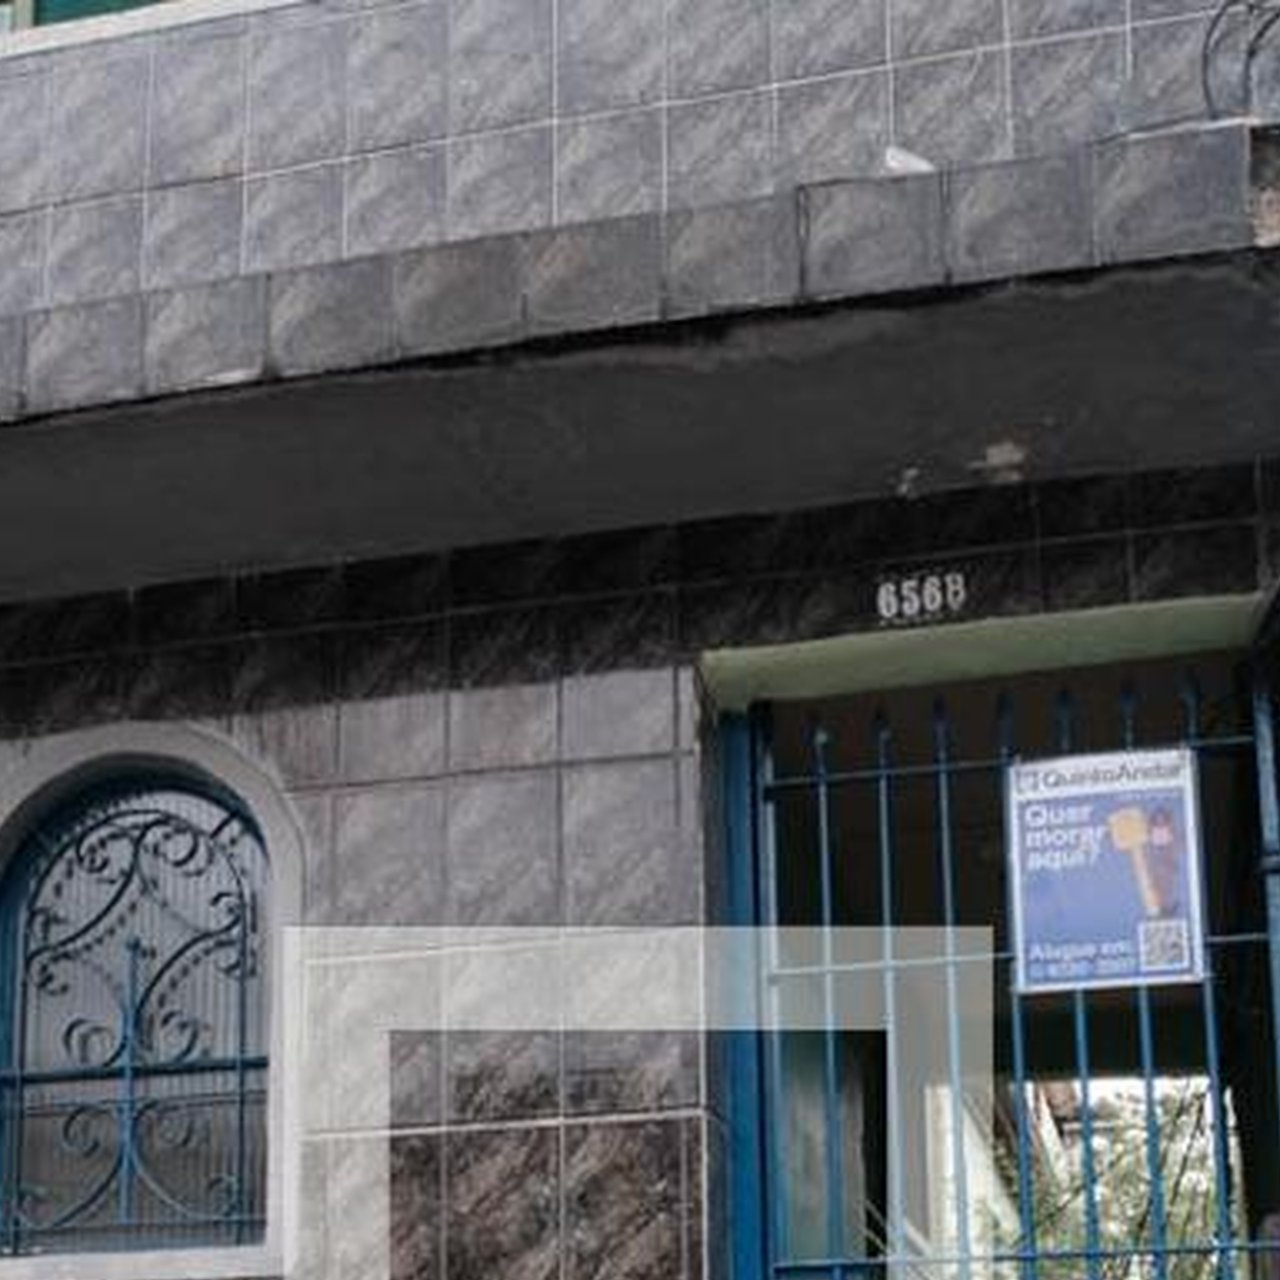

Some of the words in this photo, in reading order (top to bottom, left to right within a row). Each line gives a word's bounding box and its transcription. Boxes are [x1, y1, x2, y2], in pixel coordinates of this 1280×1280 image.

[1025, 804, 1092, 827] Quer
[1026, 826, 1105, 848] morar
[1028, 848, 1099, 870] aqui?
